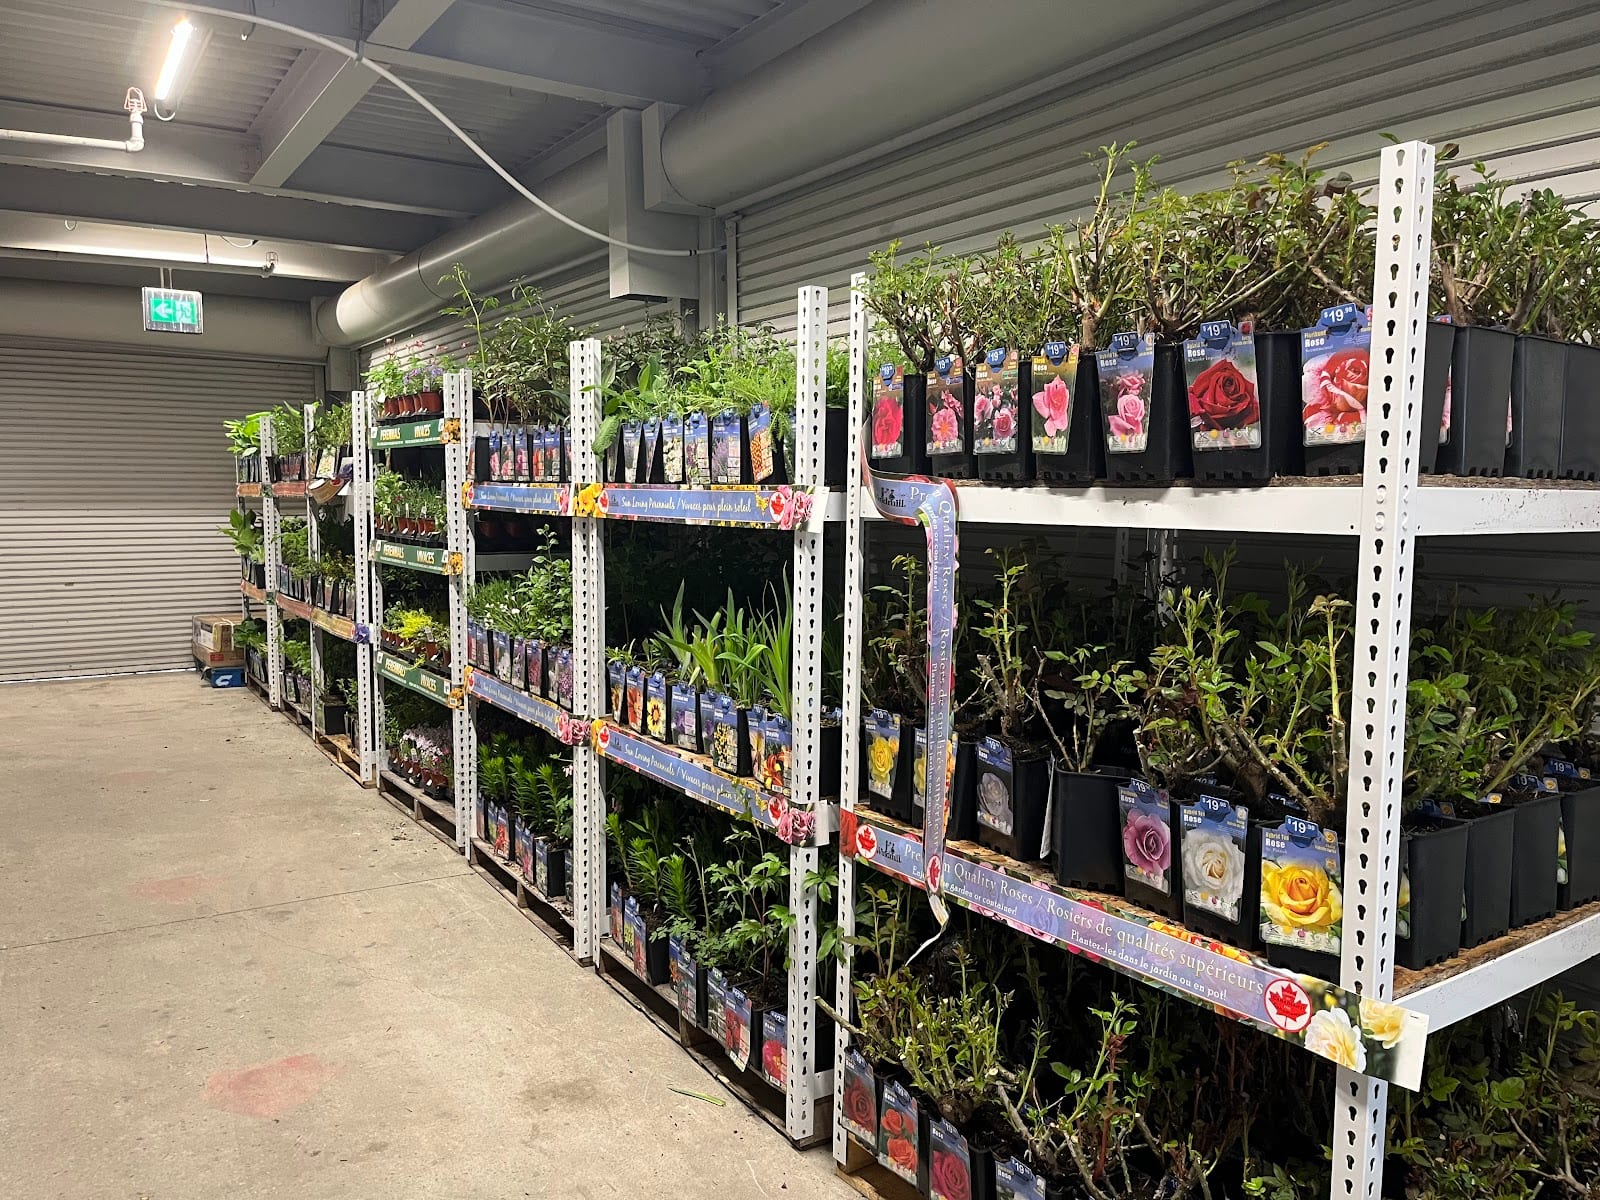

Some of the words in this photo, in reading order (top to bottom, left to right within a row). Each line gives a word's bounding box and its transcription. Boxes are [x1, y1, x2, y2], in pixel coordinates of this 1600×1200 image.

[1265, 838, 1286, 848] Rose
[954, 862, 997, 890] Quality
[1000, 880, 1033, 905] Roses
[1047, 897, 1093, 930] Rosiers
[1096, 917, 1112, 937] de
[1117, 930, 1176, 961] qualités
[1179, 952, 1264, 995] supérieurs
[1071, 929, 1117, 957] Plantez-les
[1118, 948, 1138, 965] dans
[1140, 956, 1149, 970] le
[1149, 965, 1178, 982] jardin
[1179, 976, 1191, 987] ou
[1193, 982, 1205, 993] en
[1207, 988, 1227, 1001] pot!
